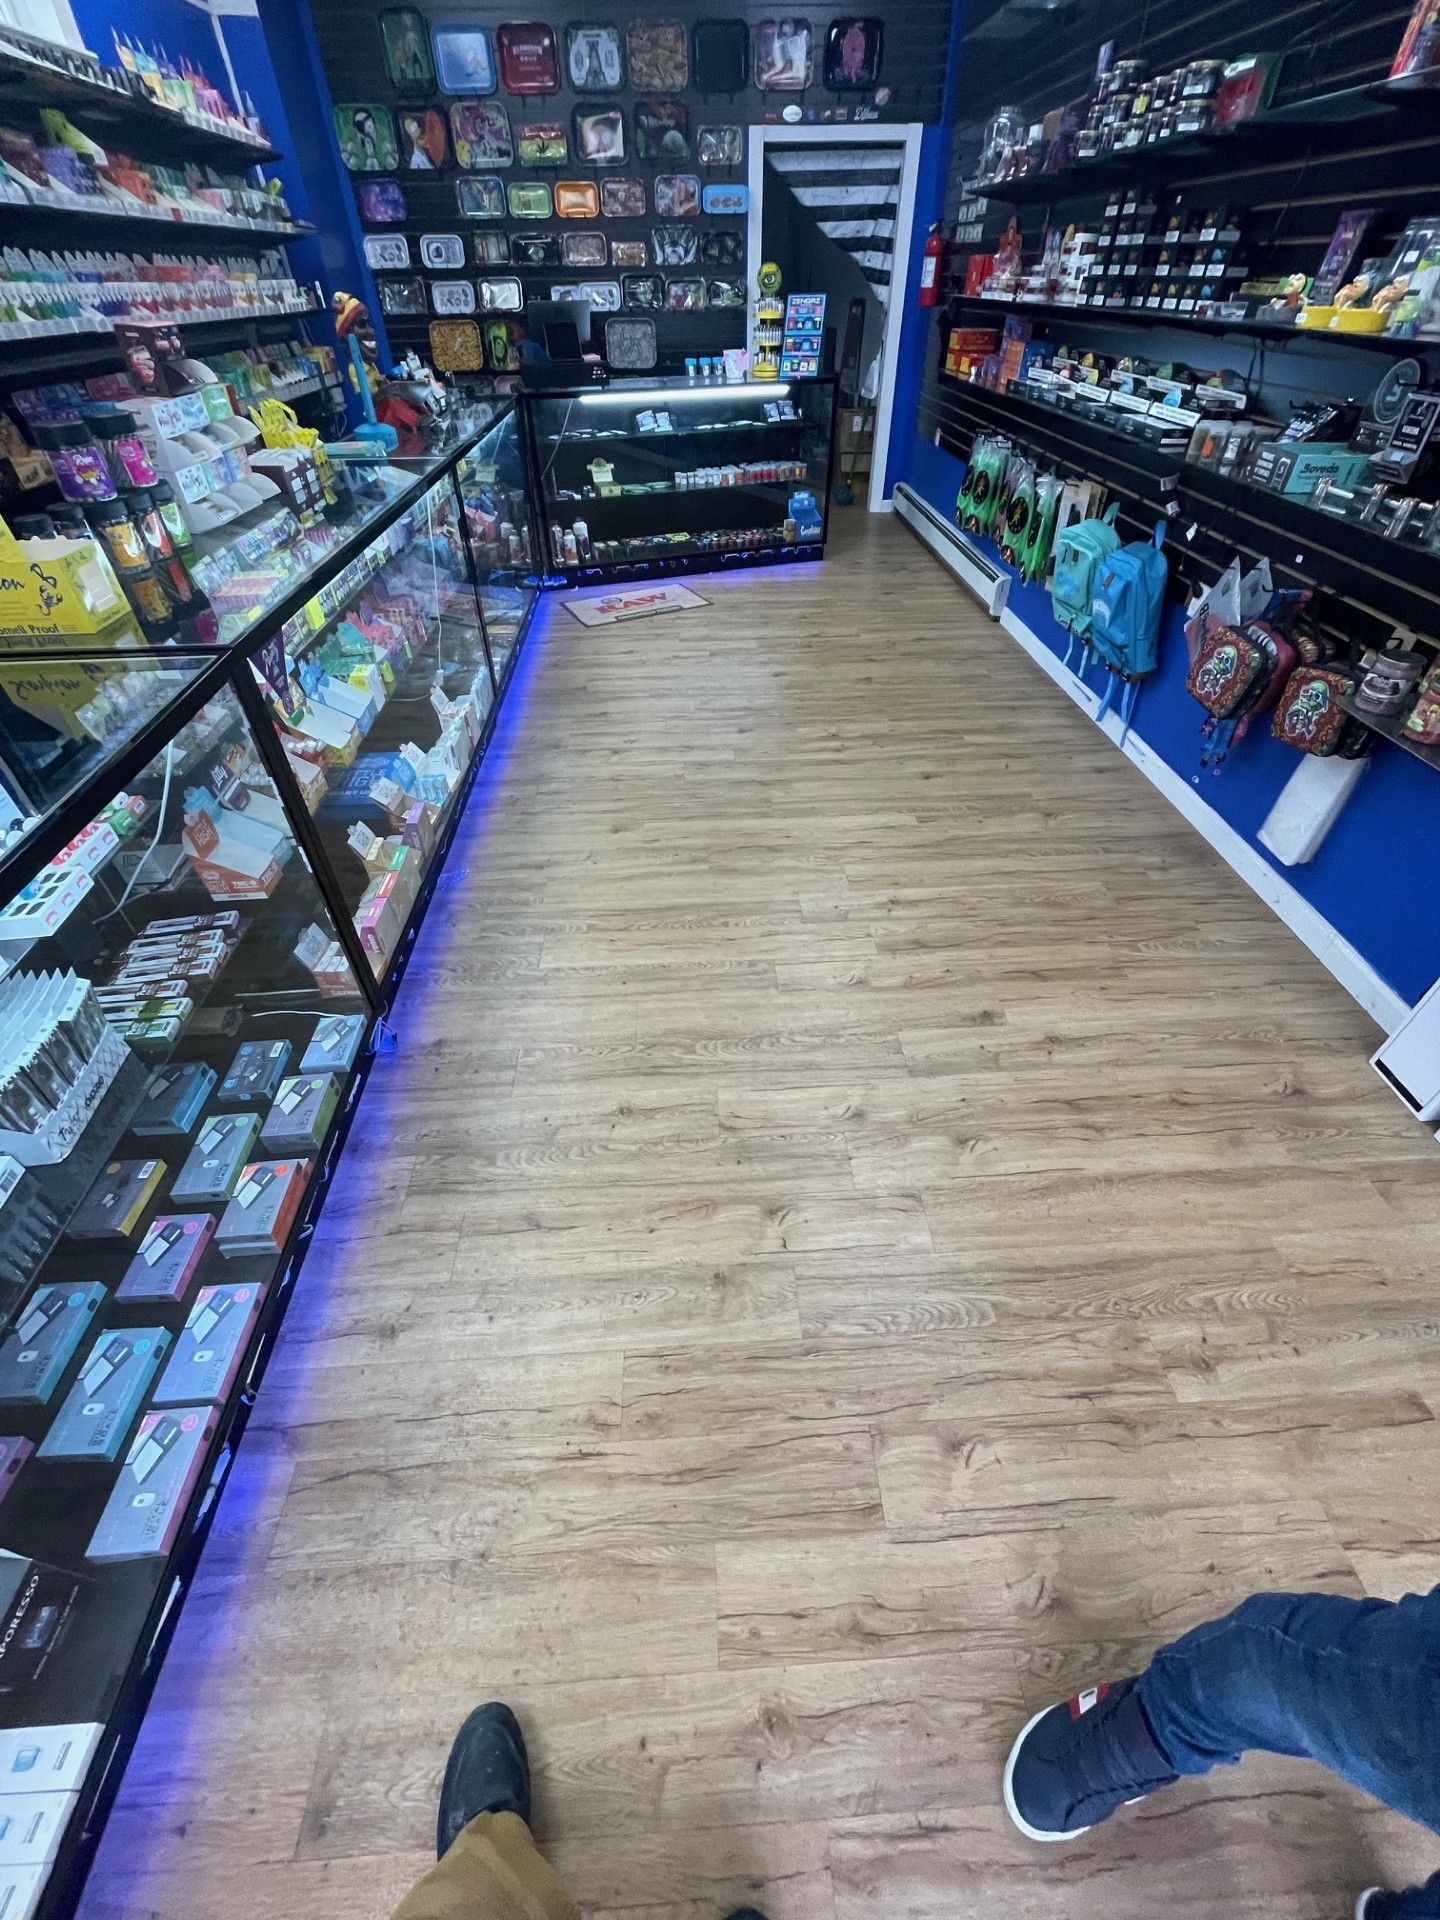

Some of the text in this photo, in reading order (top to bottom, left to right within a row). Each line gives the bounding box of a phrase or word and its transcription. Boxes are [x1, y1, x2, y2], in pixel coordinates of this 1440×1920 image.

[791, 297, 821, 305] ZENGAZ
[595, 592, 667, 614] RAW
[28, 623, 59, 634] Proof
